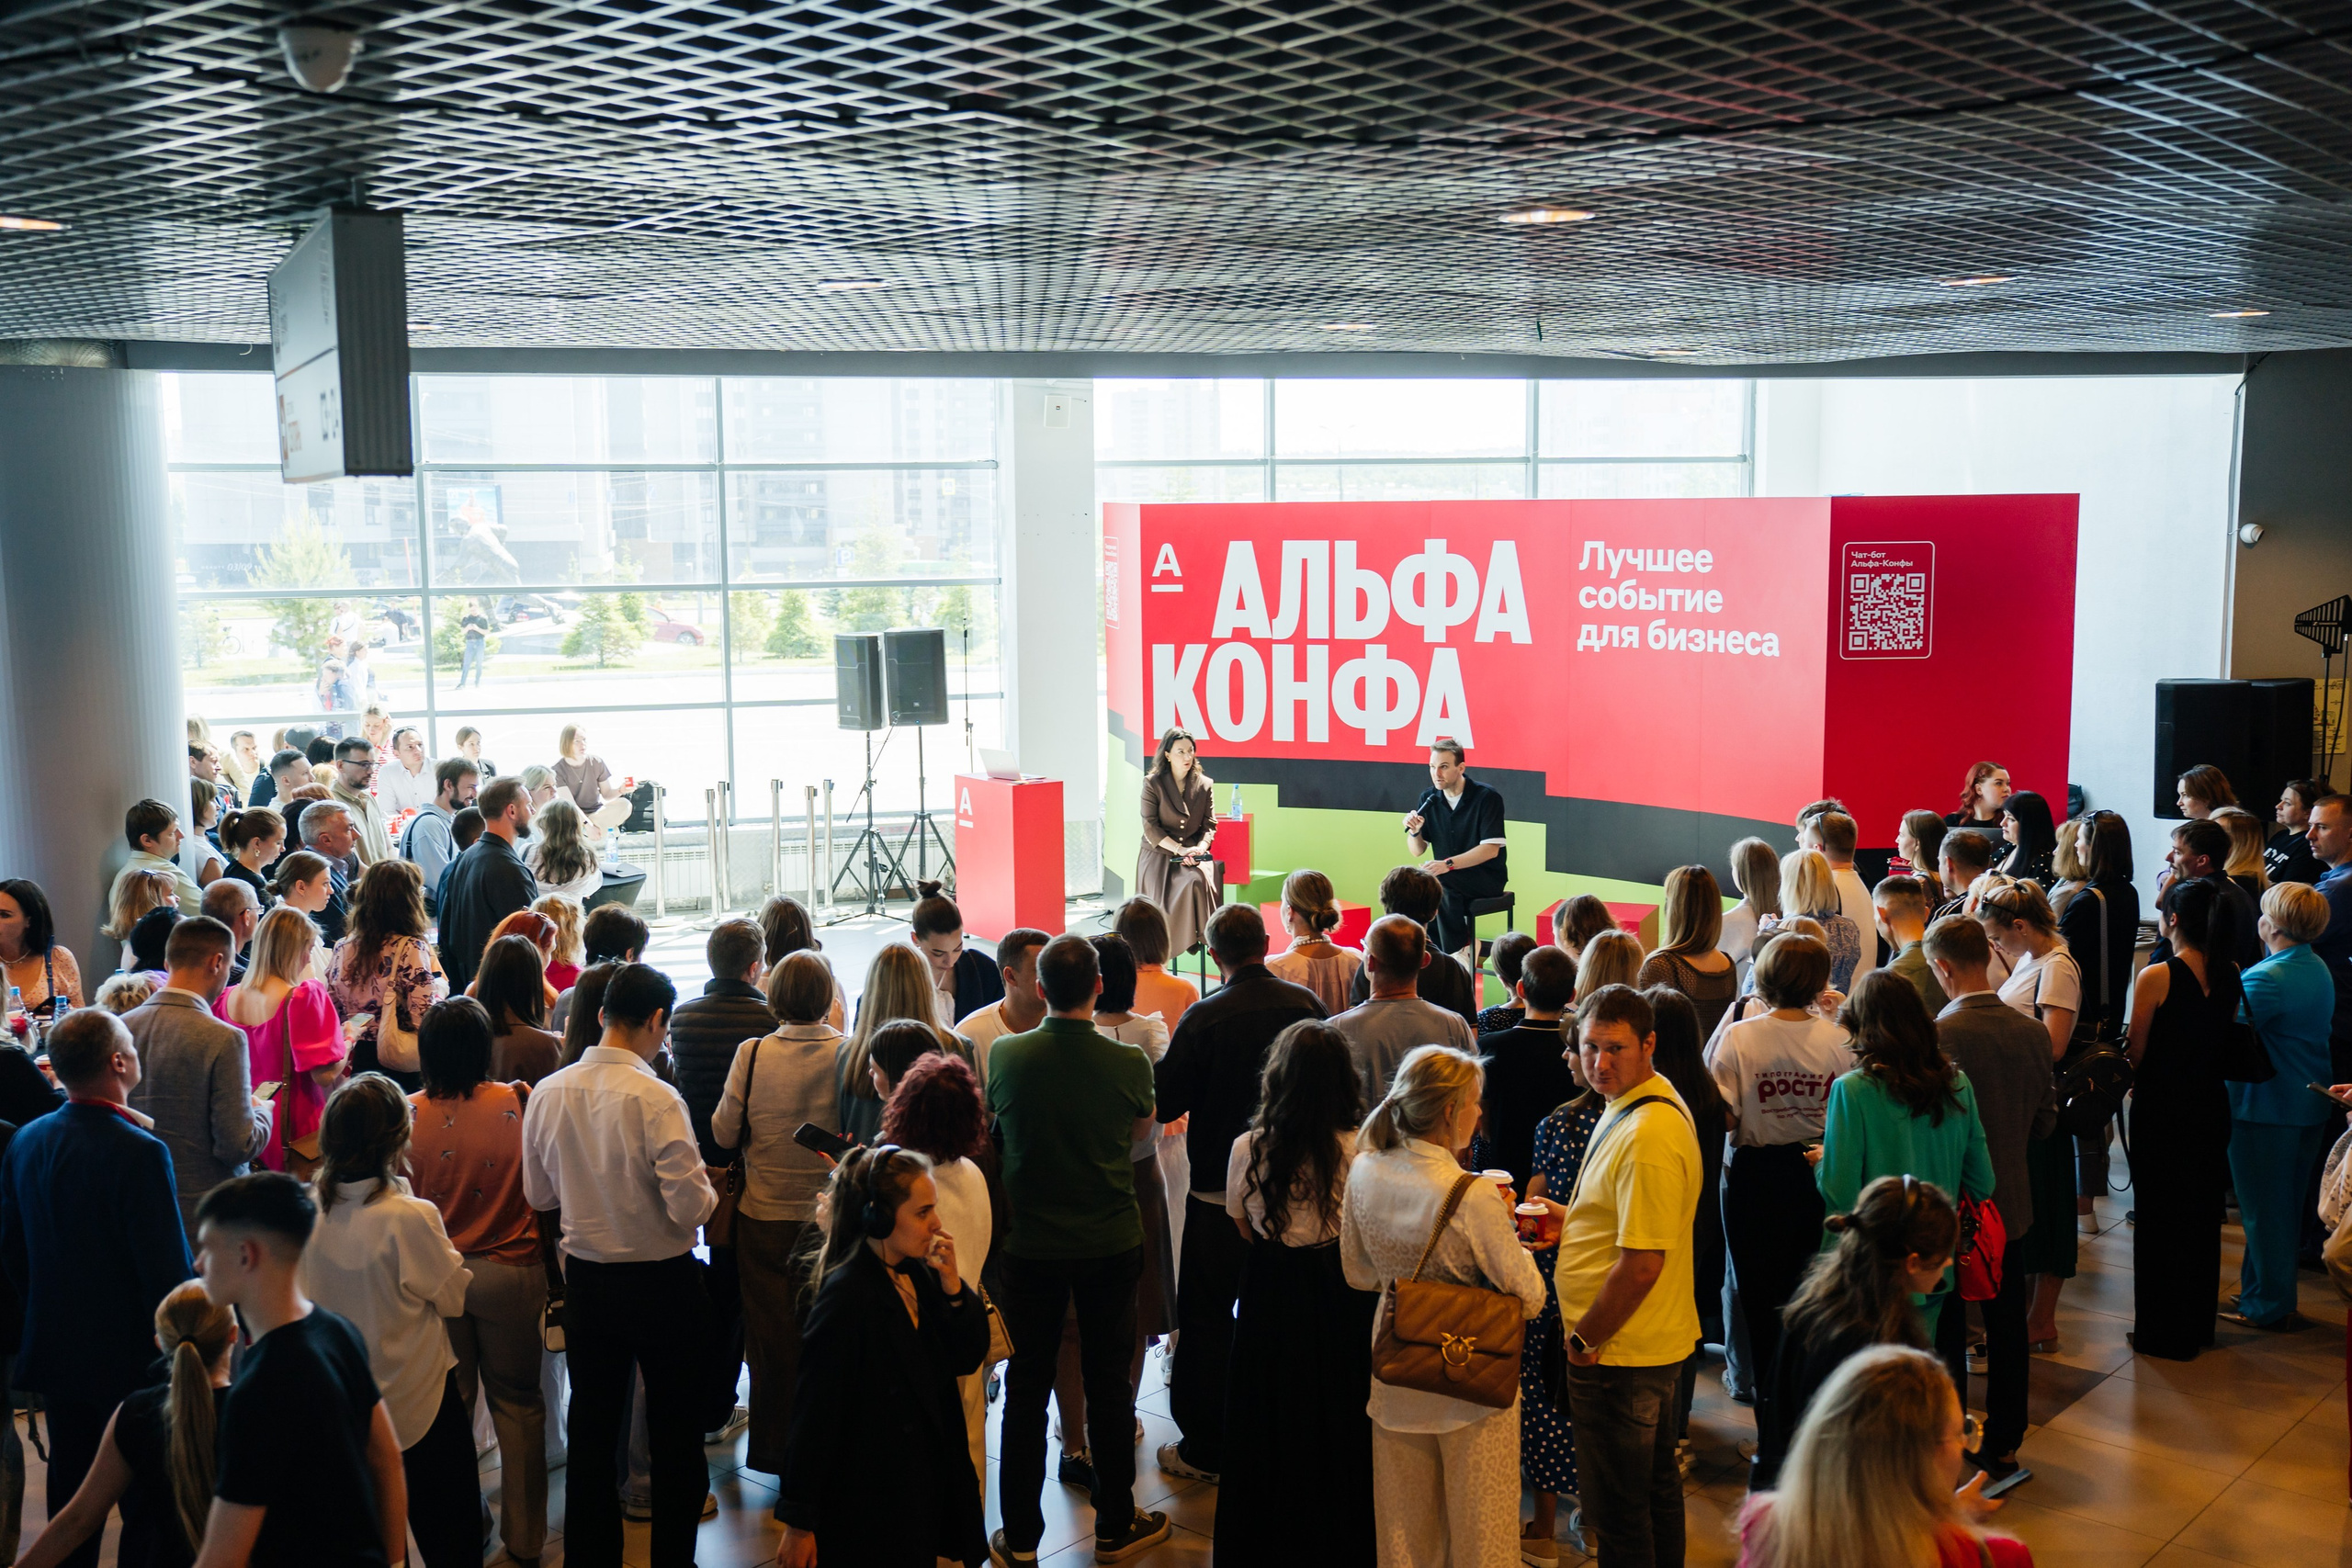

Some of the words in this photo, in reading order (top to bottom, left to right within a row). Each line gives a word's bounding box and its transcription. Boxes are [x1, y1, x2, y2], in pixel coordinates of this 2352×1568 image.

[1578, 540, 1713, 579] Лучшее
[1850, 559, 1914, 569] Альфа-Конфы
[1211, 538, 1532, 644] АЛЬФА
[1578, 579, 1724, 614] событие
[1577, 624, 1640, 652] для
[1647, 618, 1781, 657] бизнеса
[1152, 641, 1475, 750] КОНФА
[1754, 1071, 1824, 1080] ТИПОГРАФИЯ
